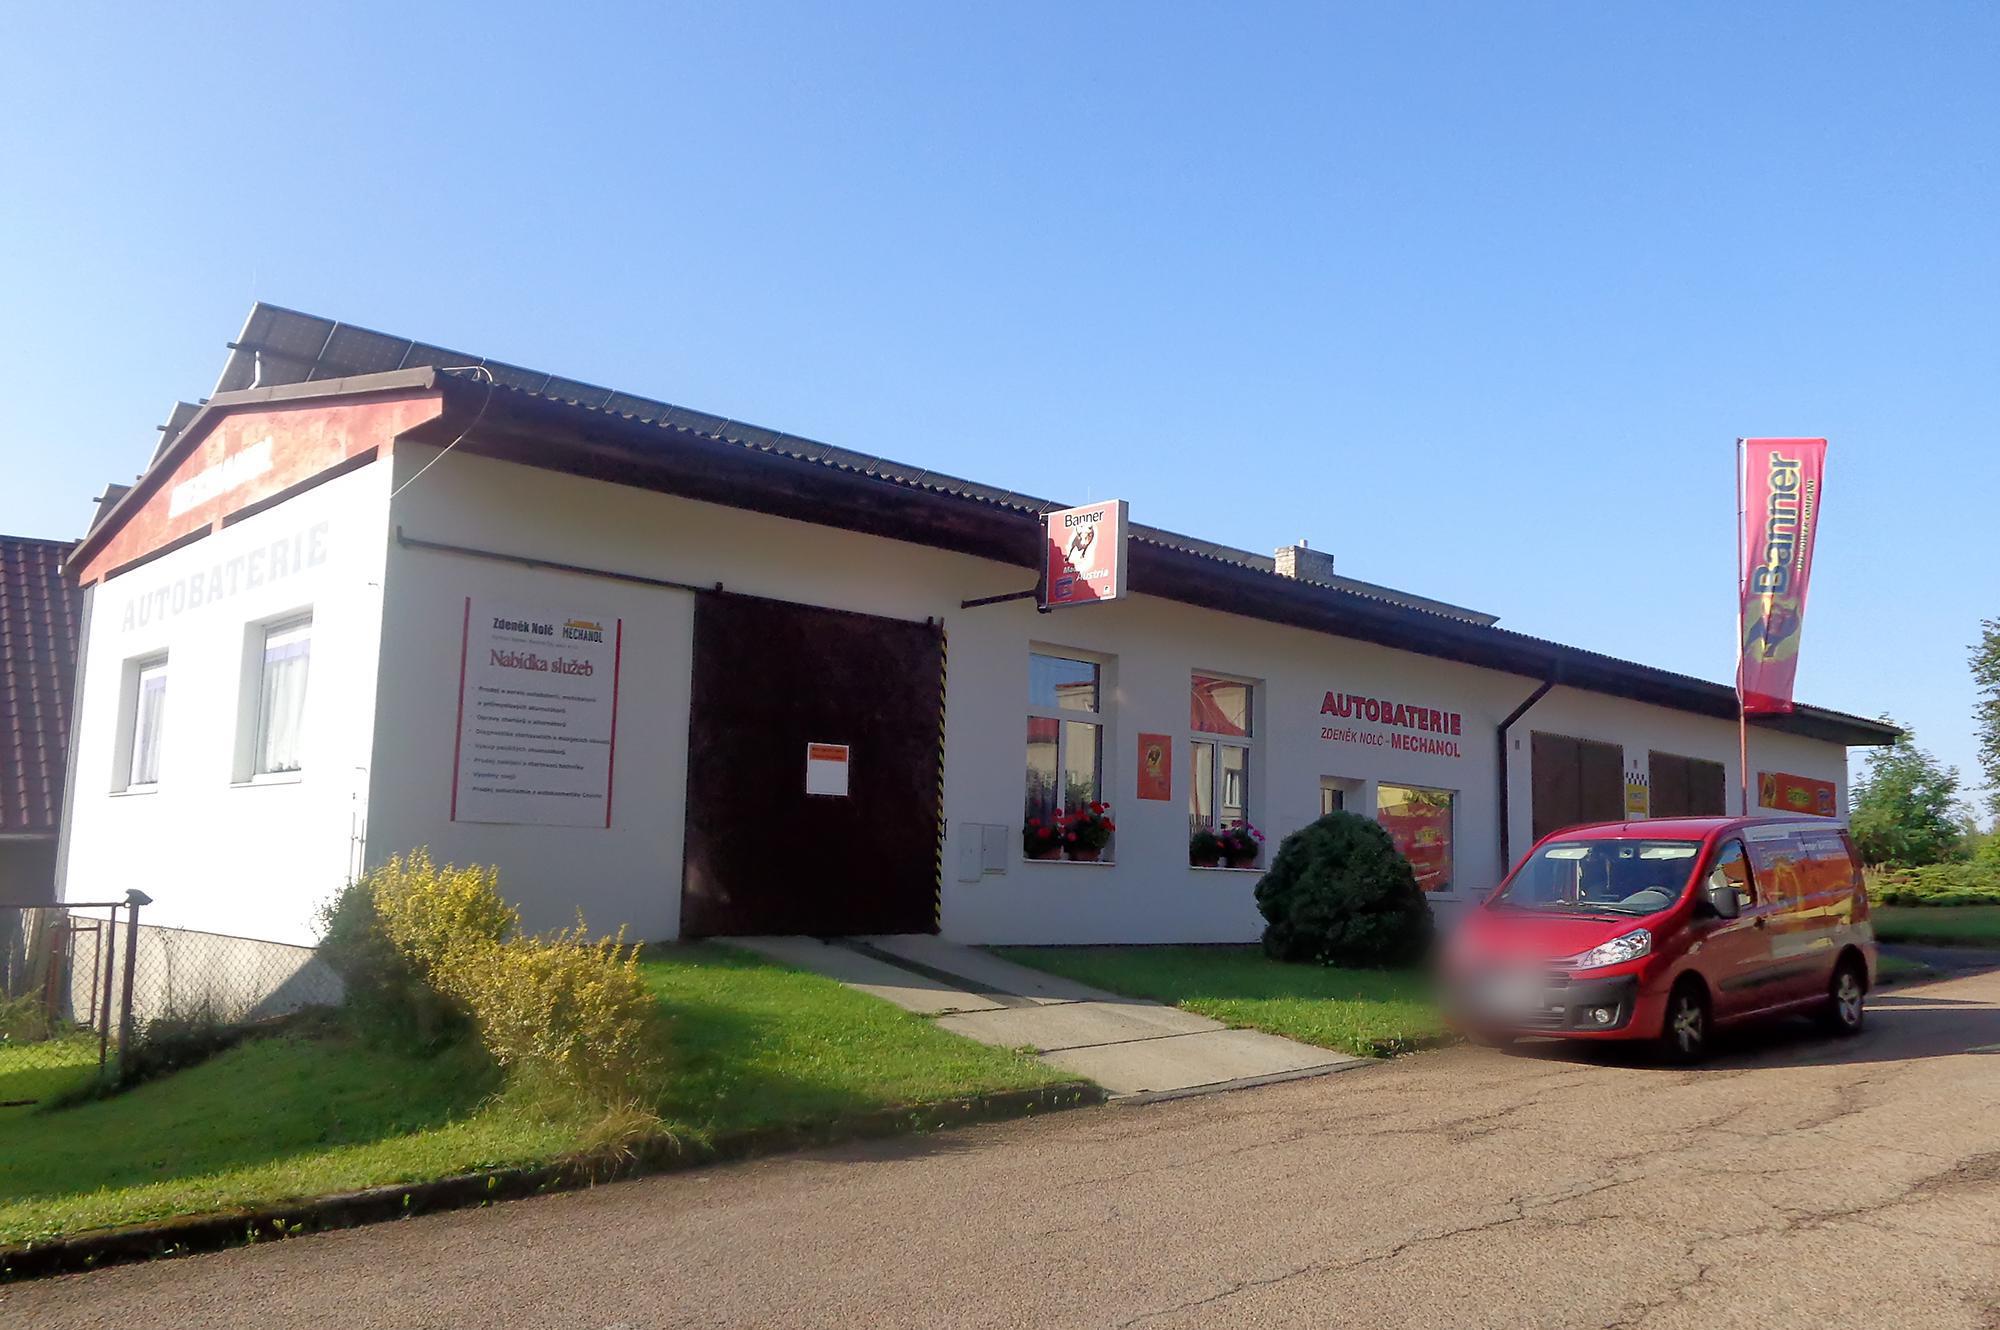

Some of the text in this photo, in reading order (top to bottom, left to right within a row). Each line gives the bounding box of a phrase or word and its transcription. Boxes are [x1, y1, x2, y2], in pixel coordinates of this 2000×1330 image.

[1064, 510, 1104, 528] Banner
[1753, 451, 1801, 595] Banner
[121, 520, 328, 632] AUTOBATERIE
[563, 627, 603, 643] MECHANOL
[490, 649, 593, 677] Nabídka služeb
[1320, 691, 1461, 736] AUTOBATERIE
[1391, 733, 1460, 757] MECHANOL
